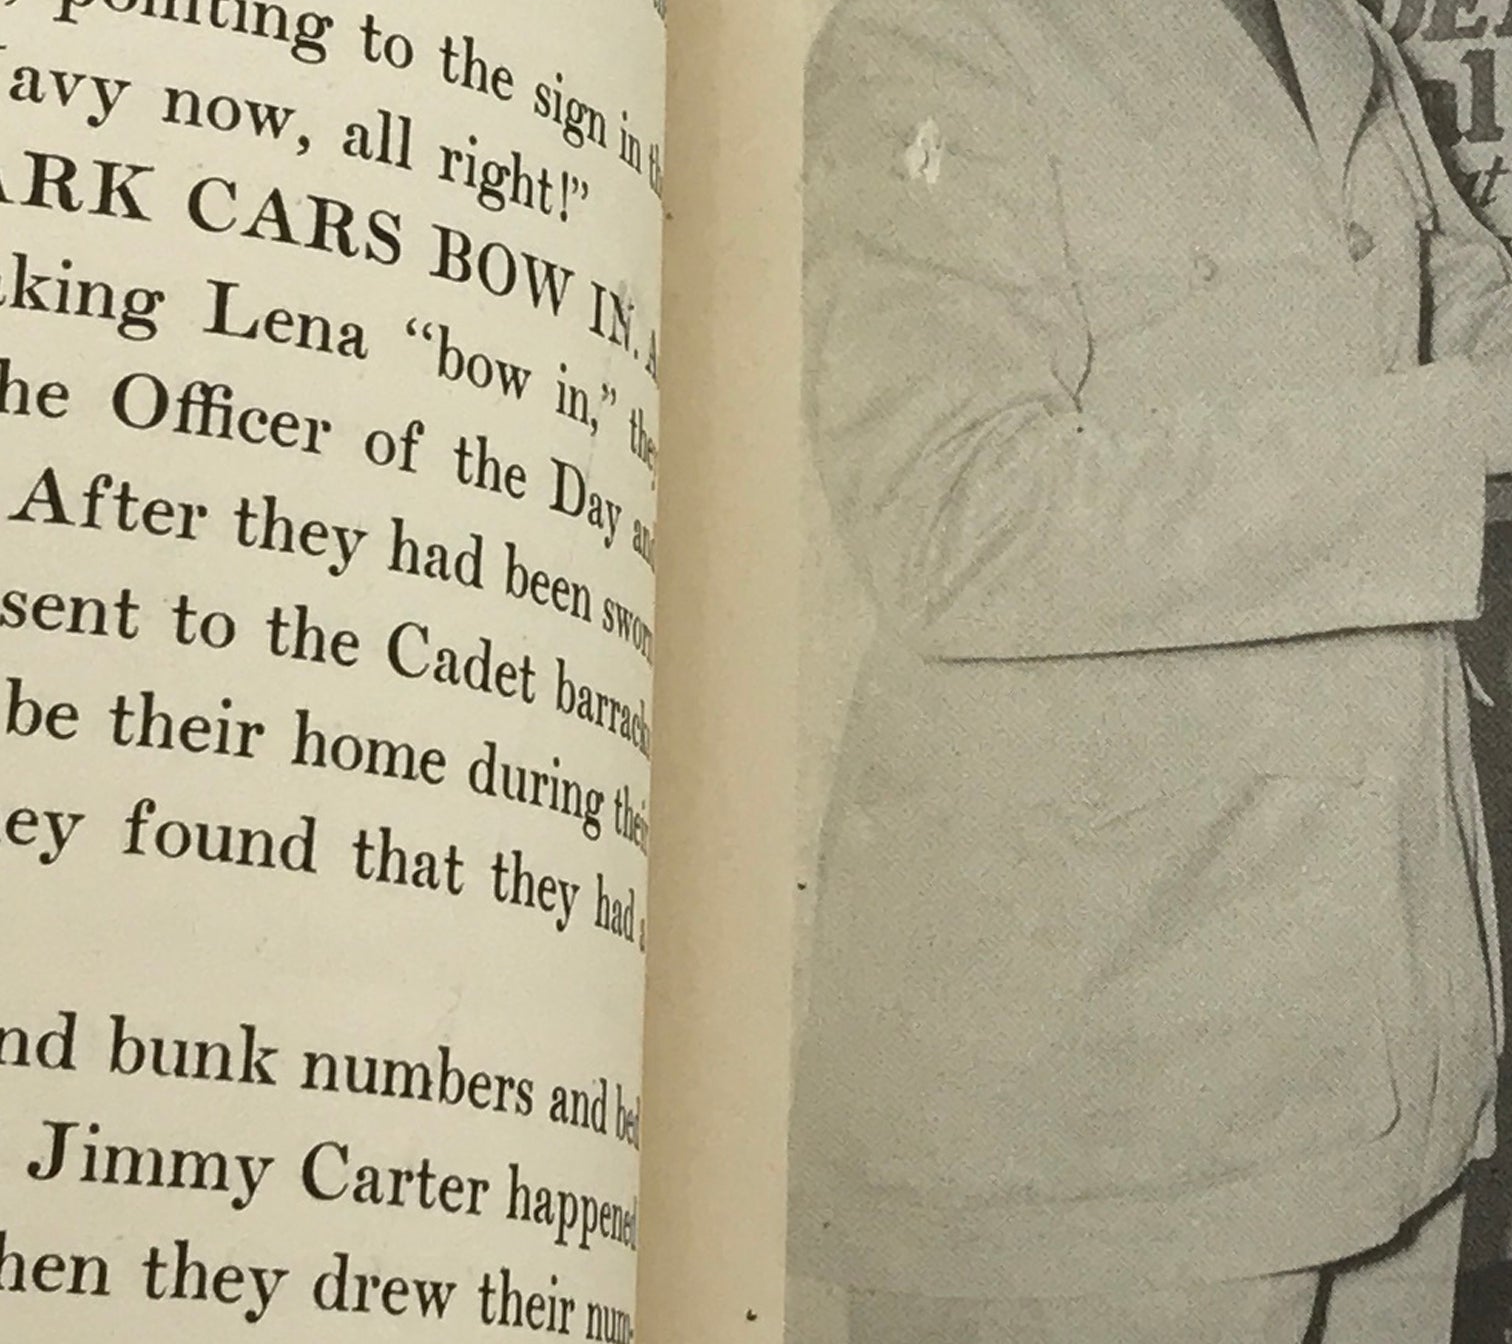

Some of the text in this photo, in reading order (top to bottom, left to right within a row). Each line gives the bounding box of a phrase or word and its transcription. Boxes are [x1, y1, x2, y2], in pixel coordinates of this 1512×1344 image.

[160, 85, 312, 158] now,
[341, 107, 414, 172] all
[436, 133, 590, 224] right!”
[358, 12, 415, 71] to
[437, 33, 515, 103] the
[532, 70, 609, 150] sign
[617, 109, 643, 176] in
[0, 148, 157, 224] RK
[186, 175, 403, 267] CARS
[427, 222, 577, 318] BOW
[587, 279, 640, 361] IN.
[201, 277, 370, 362] Lena
[404, 315, 534, 402] “bow
[554, 361, 618, 439] in,”
[110, 371, 333, 456] Officer
[363, 418, 427, 475] of
[451, 433, 528, 501] the
[547, 455, 624, 551] Day
[5, 465, 209, 542] After
[232, 493, 370, 579] they
[386, 515, 485, 591] had
[503, 540, 593, 625] been
[0, 586, 142, 641] sent
[170, 593, 238, 651] to
[264, 602, 361, 669] the
[386, 620, 538, 706] Cadet
[4, 675, 81, 742] be
[107, 689, 267, 760] their
[289, 707, 448, 787] home
[467, 739, 606, 843] during
[120, 796, 319, 876] found
[350, 824, 466, 898] that
[489, 848, 582, 934] they
[593, 871, 636, 944] had
[108, 1012, 280, 1087] bunk
[298, 1043, 535, 1118] numbers
[548, 1076, 609, 1137] and
[25, 1118, 638, 1253] Jimmy Carter happened
[140, 1237, 292, 1326] they
[311, 1250, 459, 1321] drew
[476, 1264, 577, 1337] their
